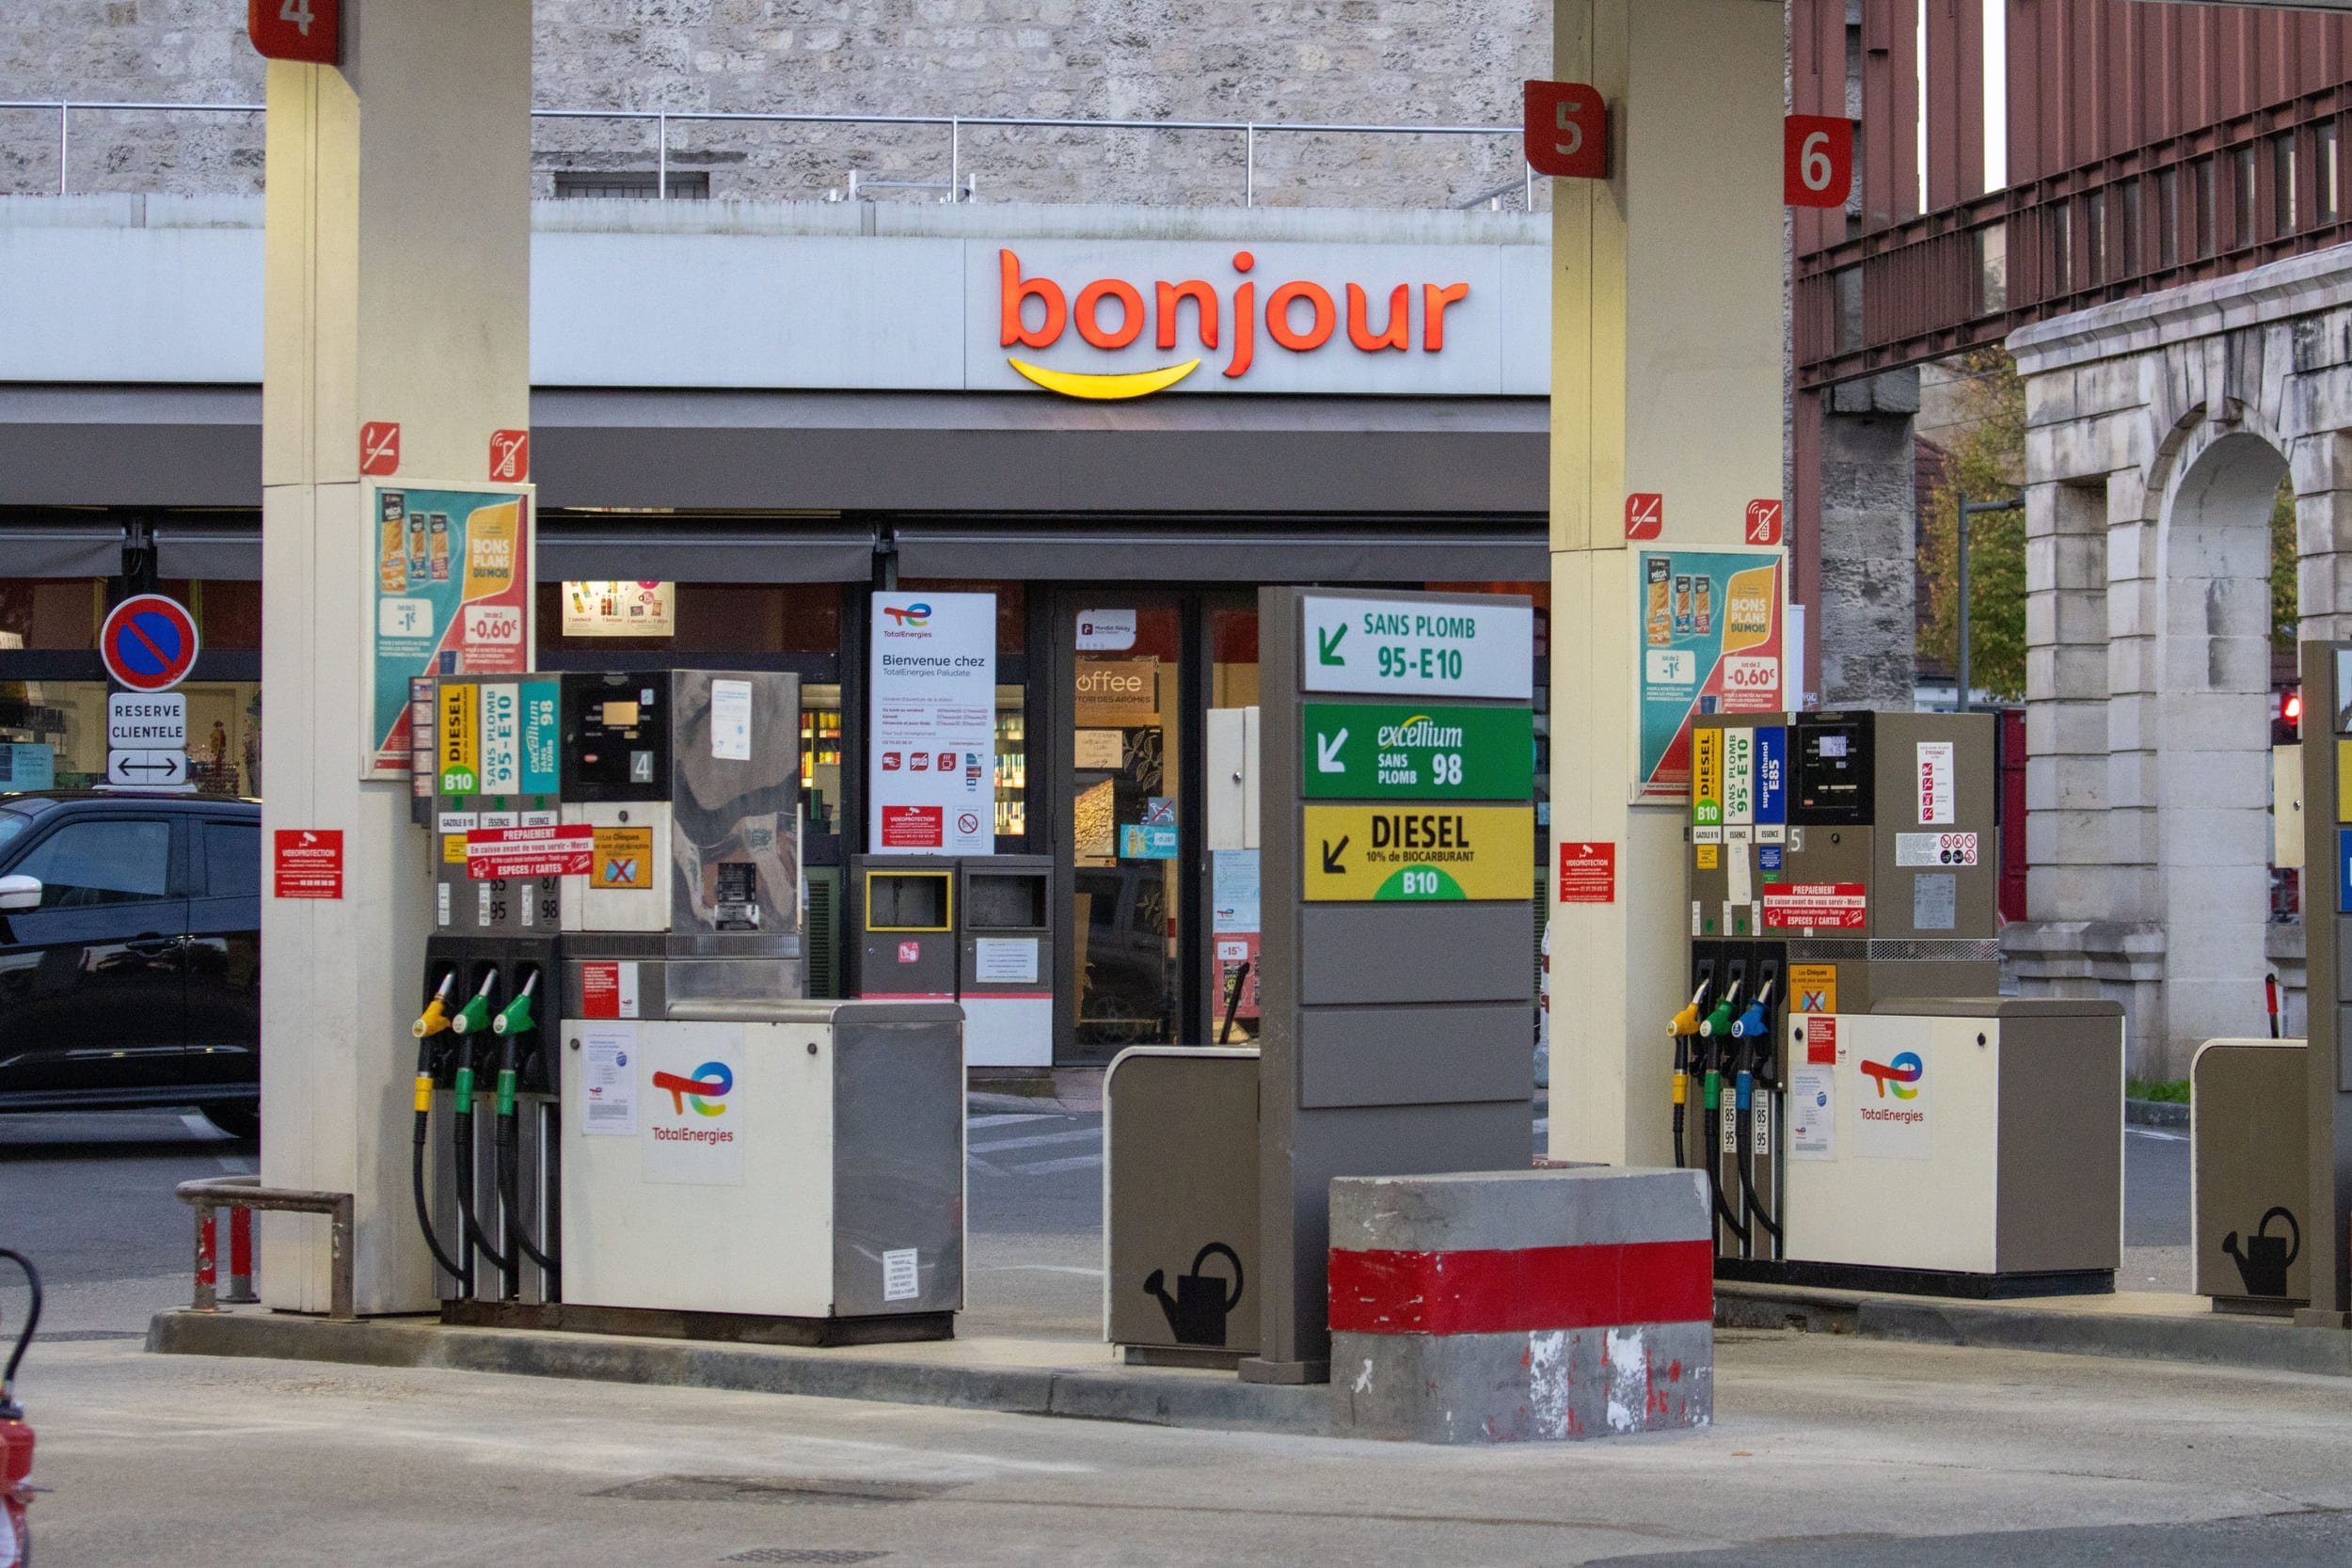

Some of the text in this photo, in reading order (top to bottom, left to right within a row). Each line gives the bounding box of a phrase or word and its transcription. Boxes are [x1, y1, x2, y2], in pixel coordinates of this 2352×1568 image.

[1555, 102, 1582, 155] 5
[1801, 131, 1833, 191] 6
[1000, 248, 1470, 379] bonjour
[473, 538, 509, 553] BONS
[473, 554, 509, 567] PLANS
[1732, 598, 1766, 611] BONS
[1732, 612, 1766, 623] PLANS
[1364, 613, 1475, 639] SANS PLOMB
[1731, 624, 1766, 632] DU MOIS
[882, 655, 984, 667] Bienvenue chez
[1378, 646, 1462, 679] 95-E10
[882, 669, 934, 677] TotalEnergies
[116, 705, 181, 717] RESERVE
[540, 700, 553, 726] 98
[112, 726, 183, 738] CLIENTELE
[449, 692, 460, 761] DIESEL
[486, 690, 496, 786] SANS PLOMB
[498, 695, 512, 781] 95-E10
[1377, 721, 1463, 750] excellium
[635, 753, 649, 780] 4
[1378, 753, 1407, 768] SANS
[1432, 753, 1463, 784] 98
[1701, 736, 1709, 796] DIESEL
[445, 774, 472, 790] B10
[1378, 769, 1417, 784] PLOMB
[1737, 739, 1748, 813] 95-E10
[1769, 759, 1779, 790] E85
[1698, 807, 1717, 820] B10
[503, 828, 556, 840] PREPAIEMENT
[1372, 816, 1470, 848] DIESEL
[1790, 829, 1801, 851] 5
[502, 844, 520, 852] avant
[548, 842, 565, 850] servir
[571, 841, 589, 849] Merci
[1367, 851, 1474, 863] 10% de BIOCARBURANT
[498, 865, 529, 875] ESPECES
[535, 863, 562, 873] CARTES
[1403, 872, 1438, 894] B10
[1792, 886, 1836, 895] PREPAIEMENT
[490, 901, 506, 919] 95
[542, 900, 558, 918] 98
[1788, 916, 1812, 925] ESPECES
[1818, 916, 1840, 925] CARTES
[1725, 1108, 1734, 1121] 85
[1756, 1110, 1766, 1123] 85
[1861, 1108, 1923, 1124] TotalEnergies
[652, 1128, 733, 1145] TotalEnergies
[1725, 1132, 1734, 1144] 95
[1756, 1132, 1766, 1146] 95
